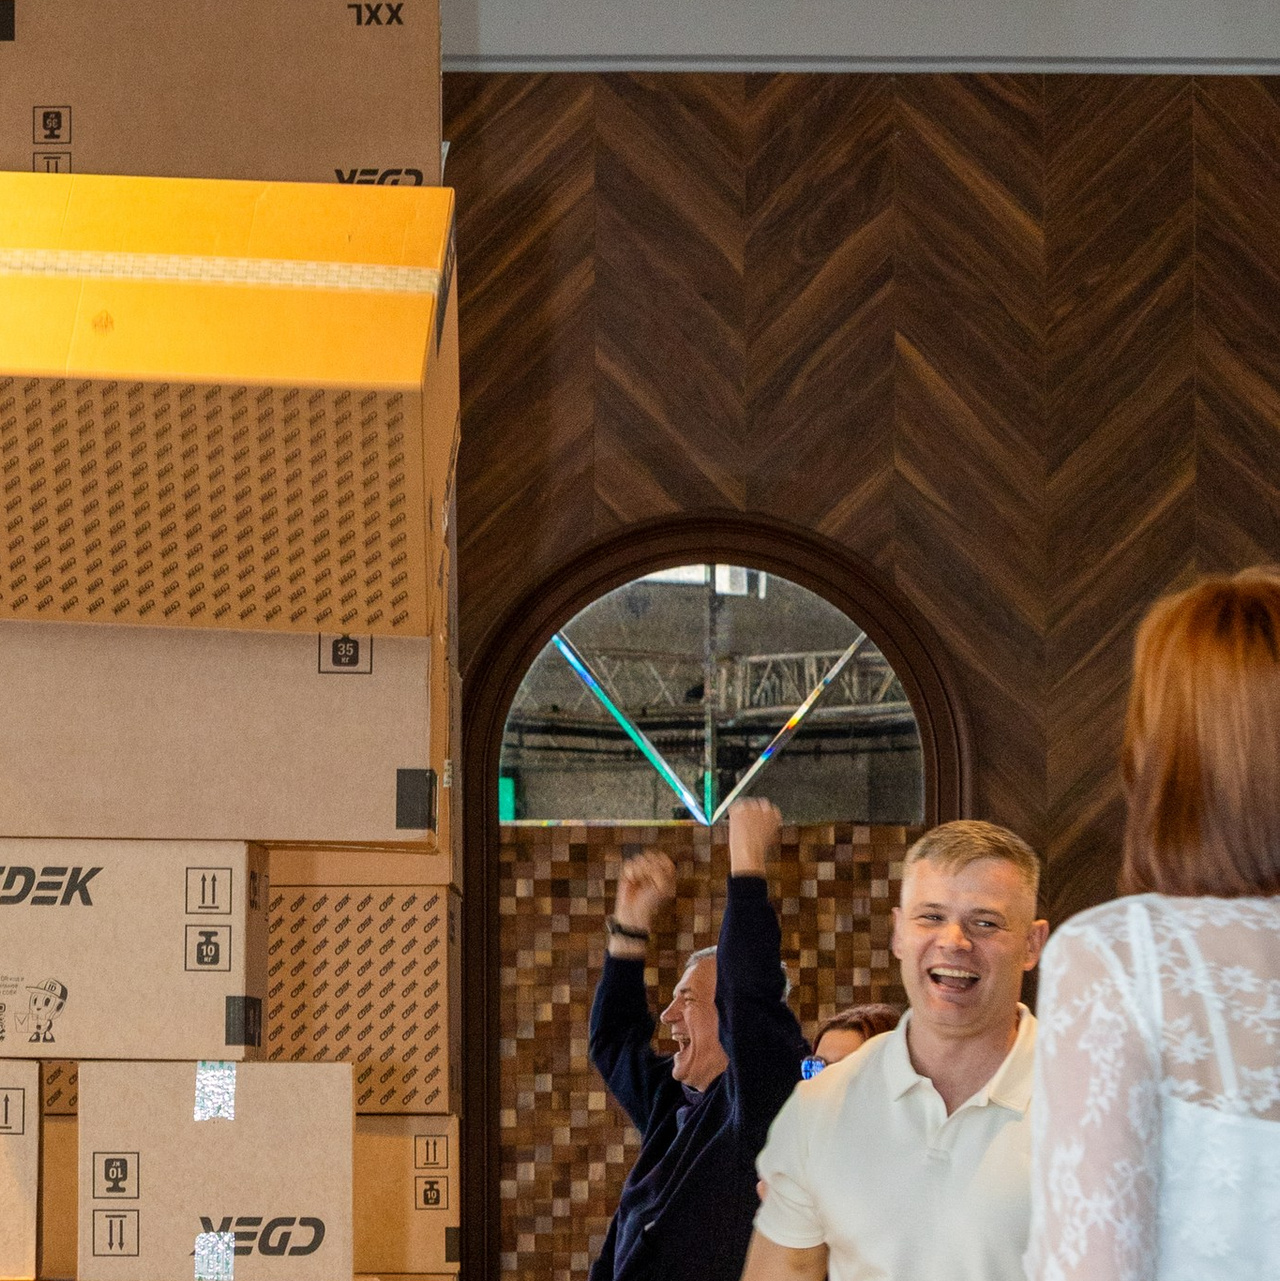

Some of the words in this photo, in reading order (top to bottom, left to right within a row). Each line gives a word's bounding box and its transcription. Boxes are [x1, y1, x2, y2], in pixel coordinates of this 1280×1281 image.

[348, 3, 403, 25] XXL
[337, 643, 354, 656] 35
[268, 894, 285, 914] CDEK
[290, 893, 308, 913] CDEK
[312, 894, 329, 913] CDEK
[334, 894, 352, 913] CDEK
[357, 894, 374, 913] CDEK
[379, 893, 396, 912] CDEK
[401, 893, 418, 912] CDEK
[423, 893, 440, 912] CDEK
[268, 916, 285, 935] CDEK
[290, 915, 308, 934] CDEK
[312, 916, 329, 934] CDEK
[335, 915, 352, 934] CDEK
[357, 915, 374, 934] CDEK
[379, 915, 396, 934] CDEK
[401, 915, 418, 934] CDEK
[424, 915, 440, 934] CDEK
[201, 945, 215, 956] 10
[268, 938, 285, 956] CDEK
[290, 936, 308, 956] CDEK
[312, 937, 329, 956] CDEK
[335, 937, 352, 956] CDEK
[357, 937, 374, 956] CDEK
[379, 937, 396, 956] CDEK
[402, 936, 418, 955] CDEK
[424, 936, 440, 956] CDEK
[268, 959, 286, 977] CDEK
[290, 958, 308, 977] CDEK
[312, 959, 330, 977] CDEK
[335, 958, 352, 977] CDEK
[357, 958, 374, 977] CDEK
[379, 958, 396, 977] CDEK
[402, 958, 418, 977] CDEK
[424, 958, 441, 977] CDEK
[268, 980, 285, 999] CDEK
[290, 980, 308, 998] CDEK
[312, 980, 329, 998] CDEK
[335, 980, 352, 998] CDEK
[357, 980, 374, 999] CDEK
[379, 979, 396, 998] CDEK
[402, 980, 418, 998] CDEK
[424, 980, 440, 998] CDEK
[268, 1002, 285, 1020] CDEK
[291, 1001, 308, 1020] CDEK
[312, 1002, 330, 1020] CDEK
[335, 1001, 352, 1020] CDEK
[357, 1001, 374, 1020] CDEK
[380, 1001, 396, 1020] CDEK
[402, 1001, 418, 1020] CDEK
[424, 1001, 441, 1020] CDEK
[268, 1023, 285, 1042] CDEK
[291, 1022, 308, 1042] CDEK
[313, 1023, 330, 1042] CDEK
[335, 1023, 352, 1042] CDEK
[357, 1022, 374, 1042] CDEK
[380, 1022, 396, 1042] CDEK
[402, 1022, 419, 1042] CDEK
[424, 1022, 441, 1041] CDEK
[268, 1044, 285, 1062] CDEK
[291, 1044, 307, 1061] CDEK
[313, 1044, 329, 1061] CDEK
[335, 1044, 352, 1061] CDEK
[357, 1045, 374, 1063] CDEK
[380, 1044, 396, 1063] CDEK
[402, 1044, 419, 1063] CDEK
[424, 1044, 441, 1062] CDEK
[358, 1065, 374, 1084] CDEK
[380, 1065, 396, 1084] CDEK
[402, 1066, 419, 1084] CDEK
[424, 1065, 441, 1084] CDEK
[358, 1087, 374, 1106] CDEK
[380, 1086, 397, 1106] CDEK
[402, 1087, 419, 1106] CDEK
[424, 1087, 442, 1106] CDEK
[108, 1168, 123, 1179] 10
[426, 1190, 437, 1199] 10
